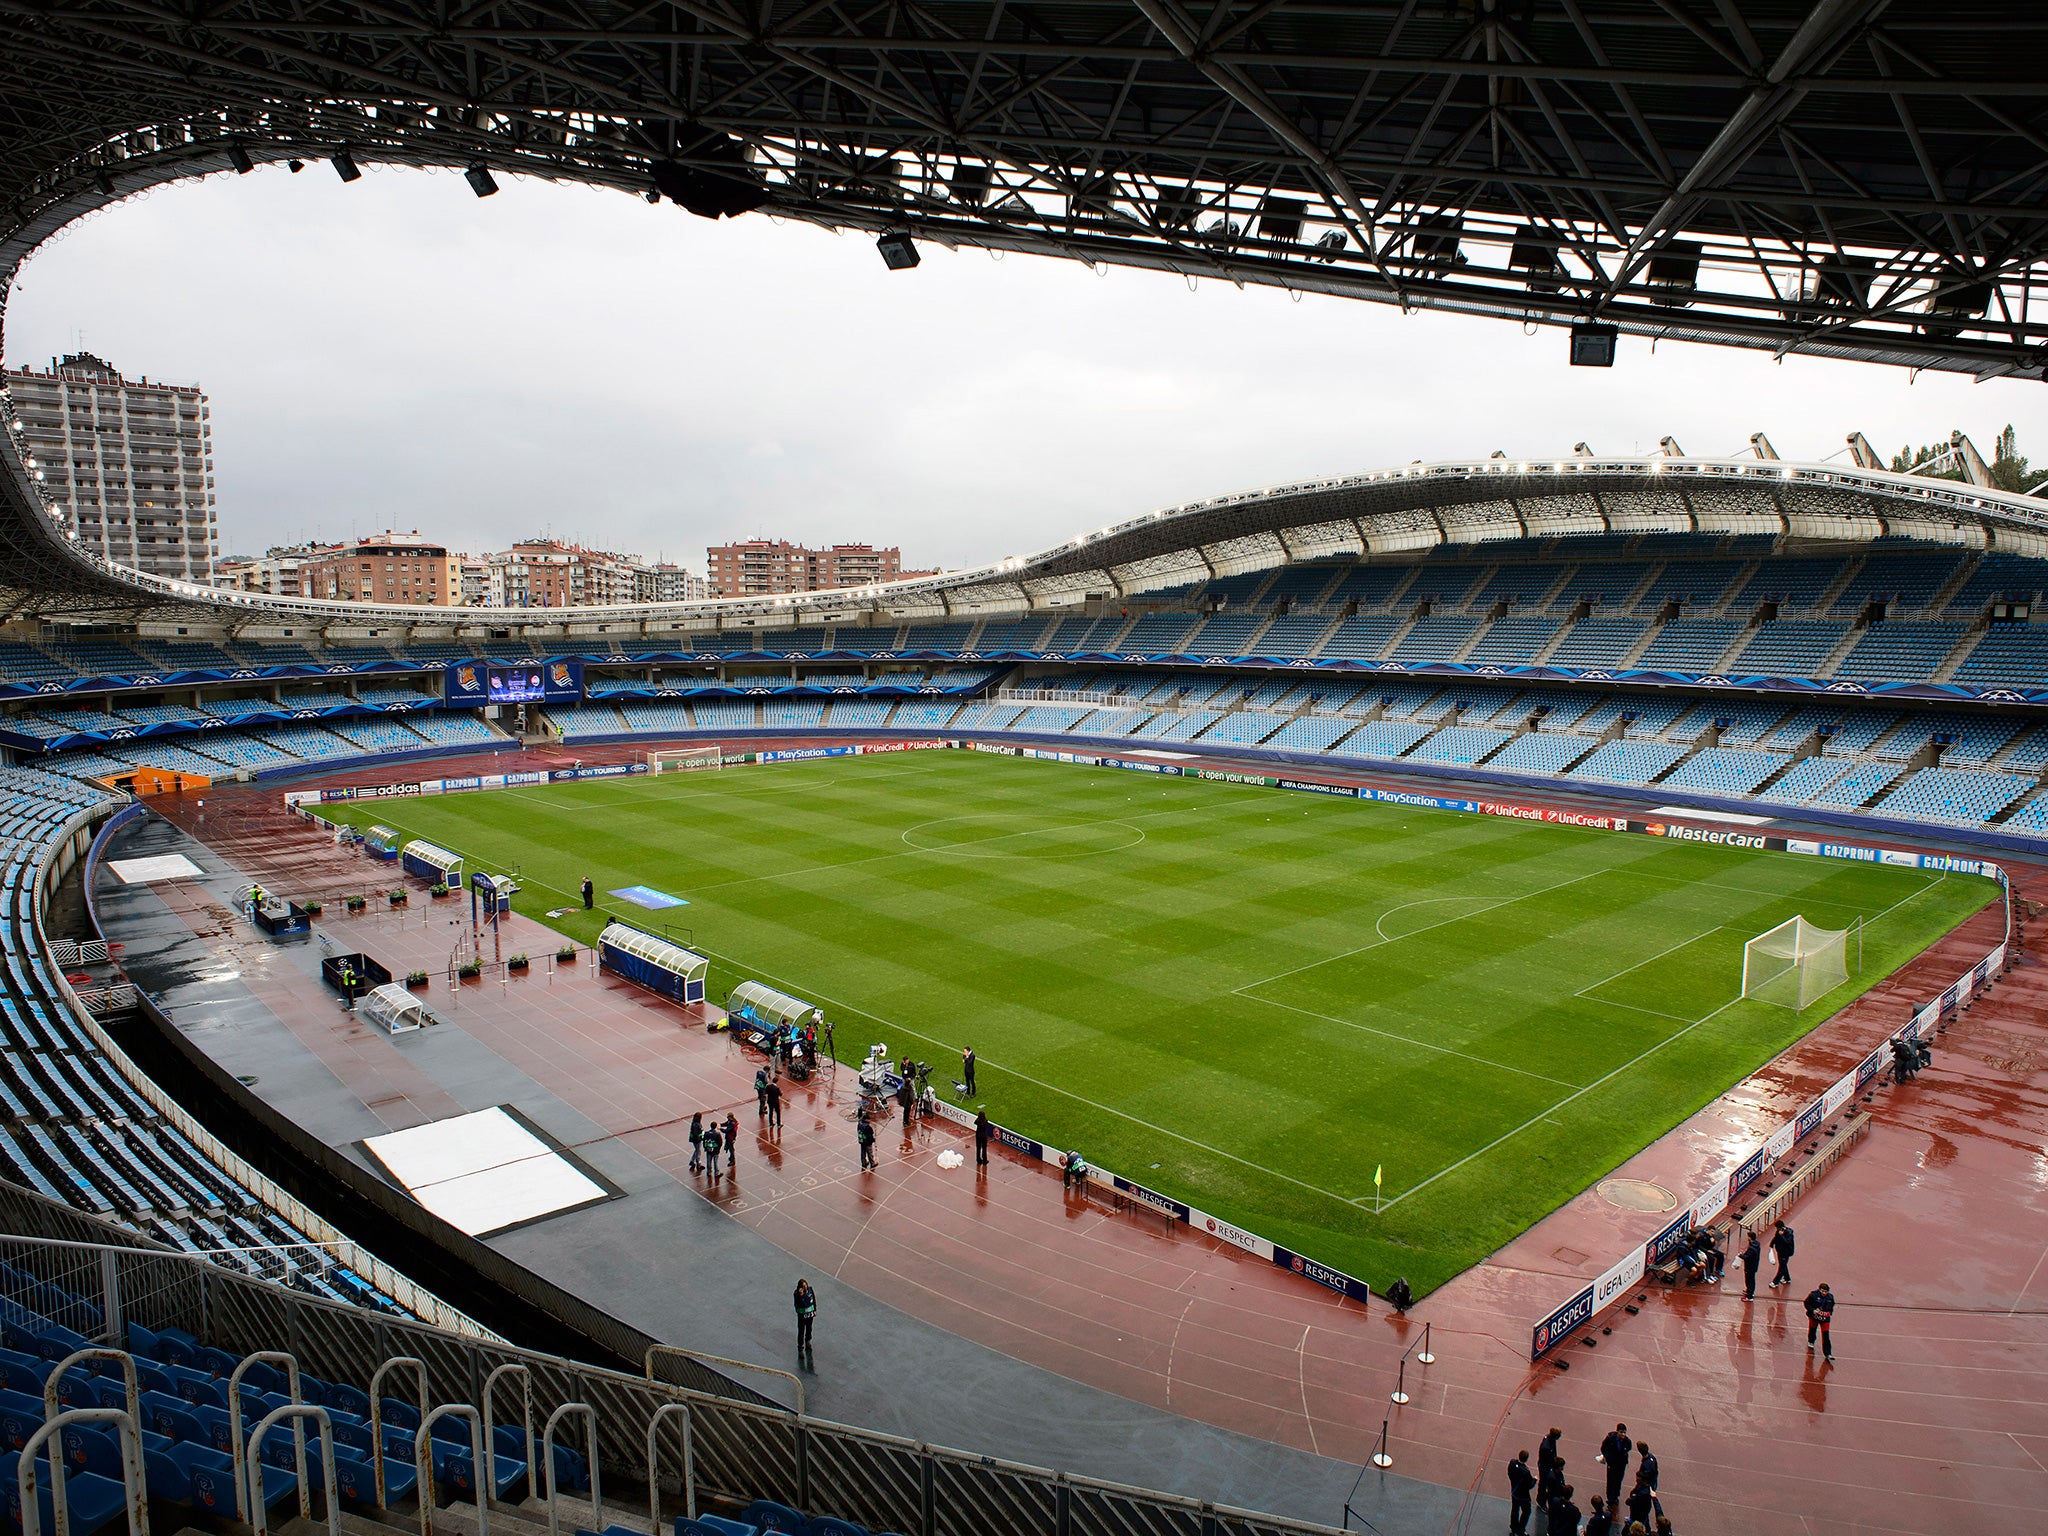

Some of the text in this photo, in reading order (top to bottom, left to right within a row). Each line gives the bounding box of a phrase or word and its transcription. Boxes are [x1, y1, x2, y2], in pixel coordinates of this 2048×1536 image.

[874, 743, 905, 753] UniCredit
[914, 740, 949, 751] UniCredit
[975, 742, 1016, 756] MasterCard
[685, 758, 706, 768] open
[725, 754, 745, 764] world
[1134, 763, 1160, 772] TOURNEO
[507, 772, 540, 785] GAZPROM
[577, 766, 627, 777] NEW TOURNEO
[1205, 770, 1265, 786] open your world
[377, 783, 420, 797] adidas
[445, 777, 480, 790] GAZPROM
[1281, 780, 1354, 796] UEFA CHAMPIONS LEAGUE
[1495, 804, 1542, 821] UniCredit
[1558, 811, 1609, 829] UniCredit
[1668, 824, 1766, 849] MasterCard
[1824, 843, 1875, 861] GAZPROM
[942, 1105, 968, 1123] RESPECT
[1002, 1131, 1031, 1151] RESPECT
[1738, 1156, 1763, 1184] RESPECT
[1140, 1190, 1175, 1211] RESPECT
[1700, 1185, 1727, 1220] RESPECT
[1218, 1224, 1256, 1248] RESPECT
[1305, 1263, 1348, 1290] RESPECT
[1599, 1261, 1641, 1301] UEFA.com
[1551, 1295, 1592, 1339] RESPECT
[69, 1439, 78, 1449] 12
[199, 1479, 208, 1489] 12
